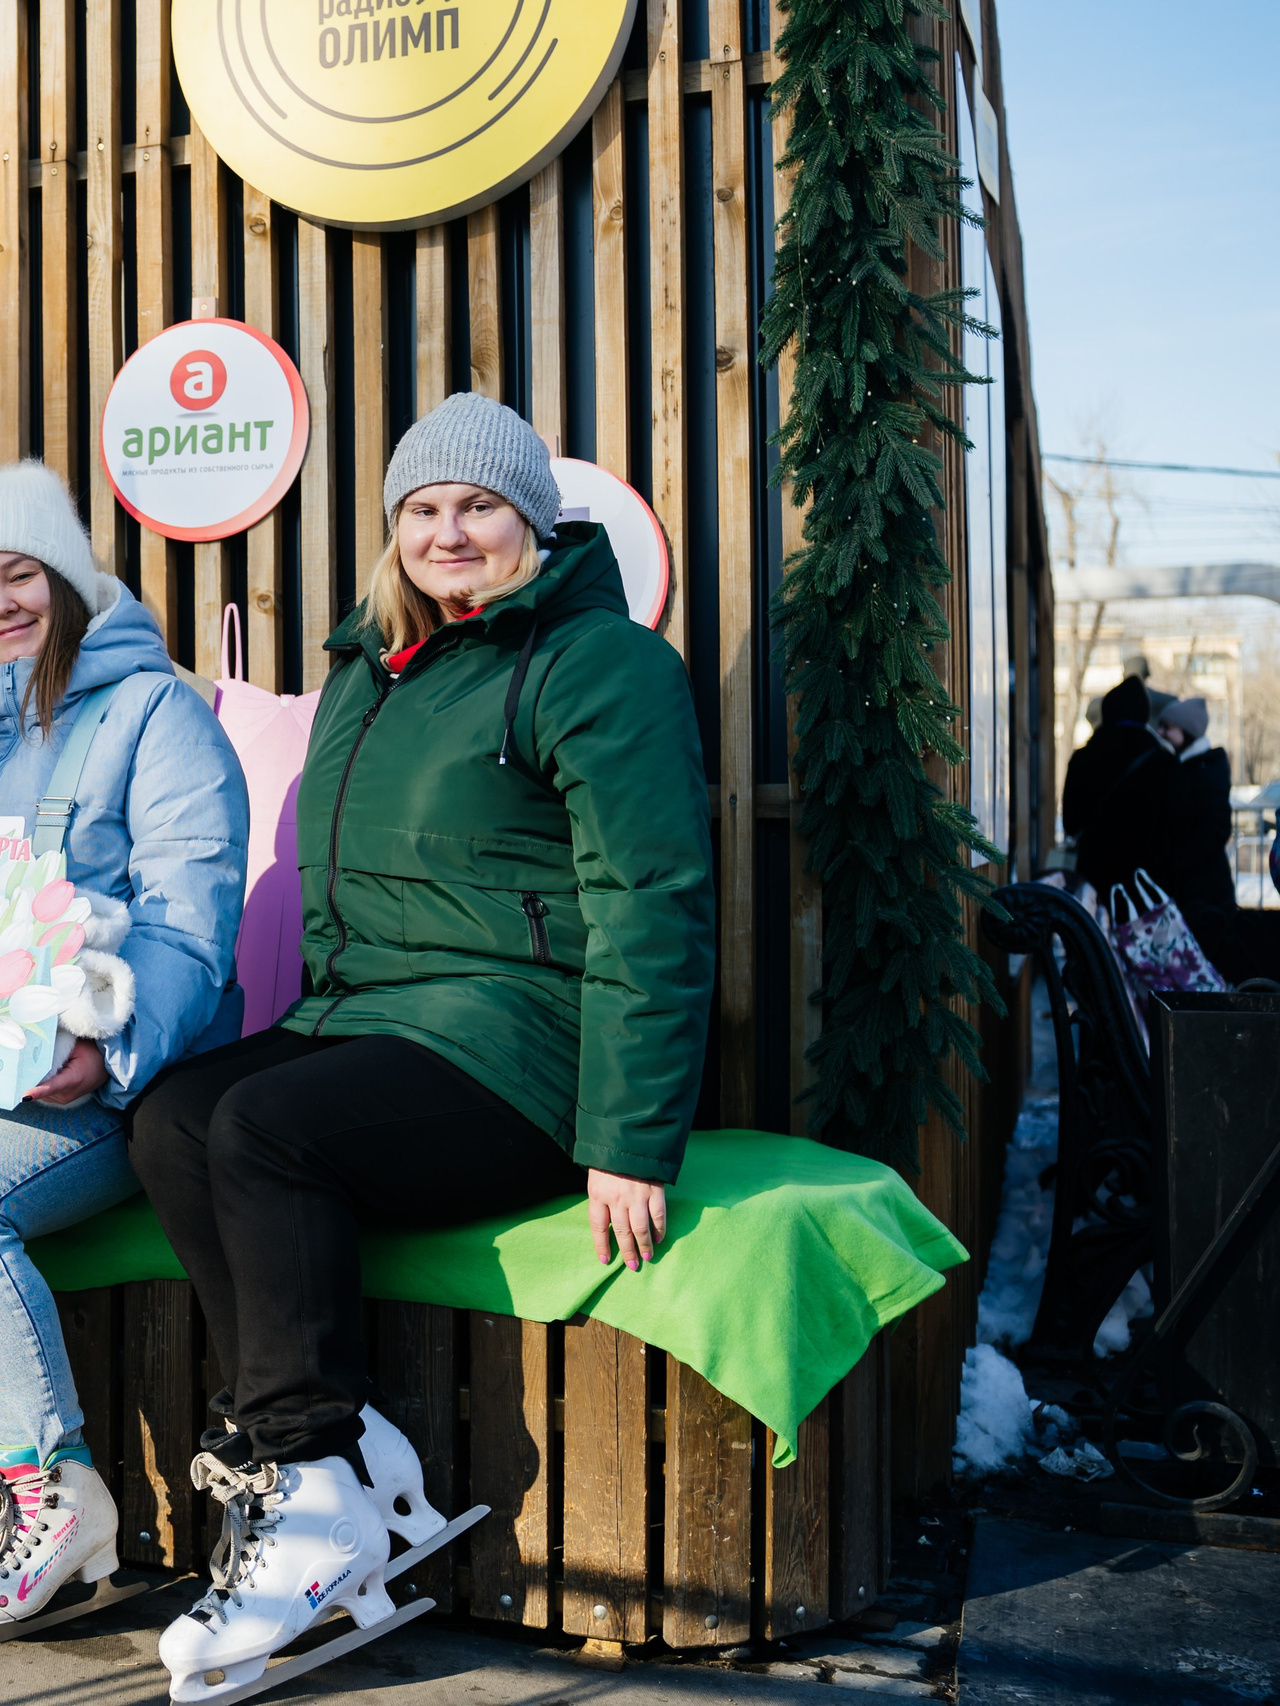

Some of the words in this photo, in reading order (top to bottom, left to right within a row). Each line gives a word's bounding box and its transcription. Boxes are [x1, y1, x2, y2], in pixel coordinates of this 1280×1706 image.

[318, 7, 459, 69] ОЛИМП
[122, 420, 274, 466] ариант
[122, 469, 149, 477] МЯСНЫЕ
[150, 468, 187, 476] ПРОДУКТЫ
[199, 464, 249, 473] СОБСТВЕННОГО
[251, 463, 274, 471] СЫРЬЯ
